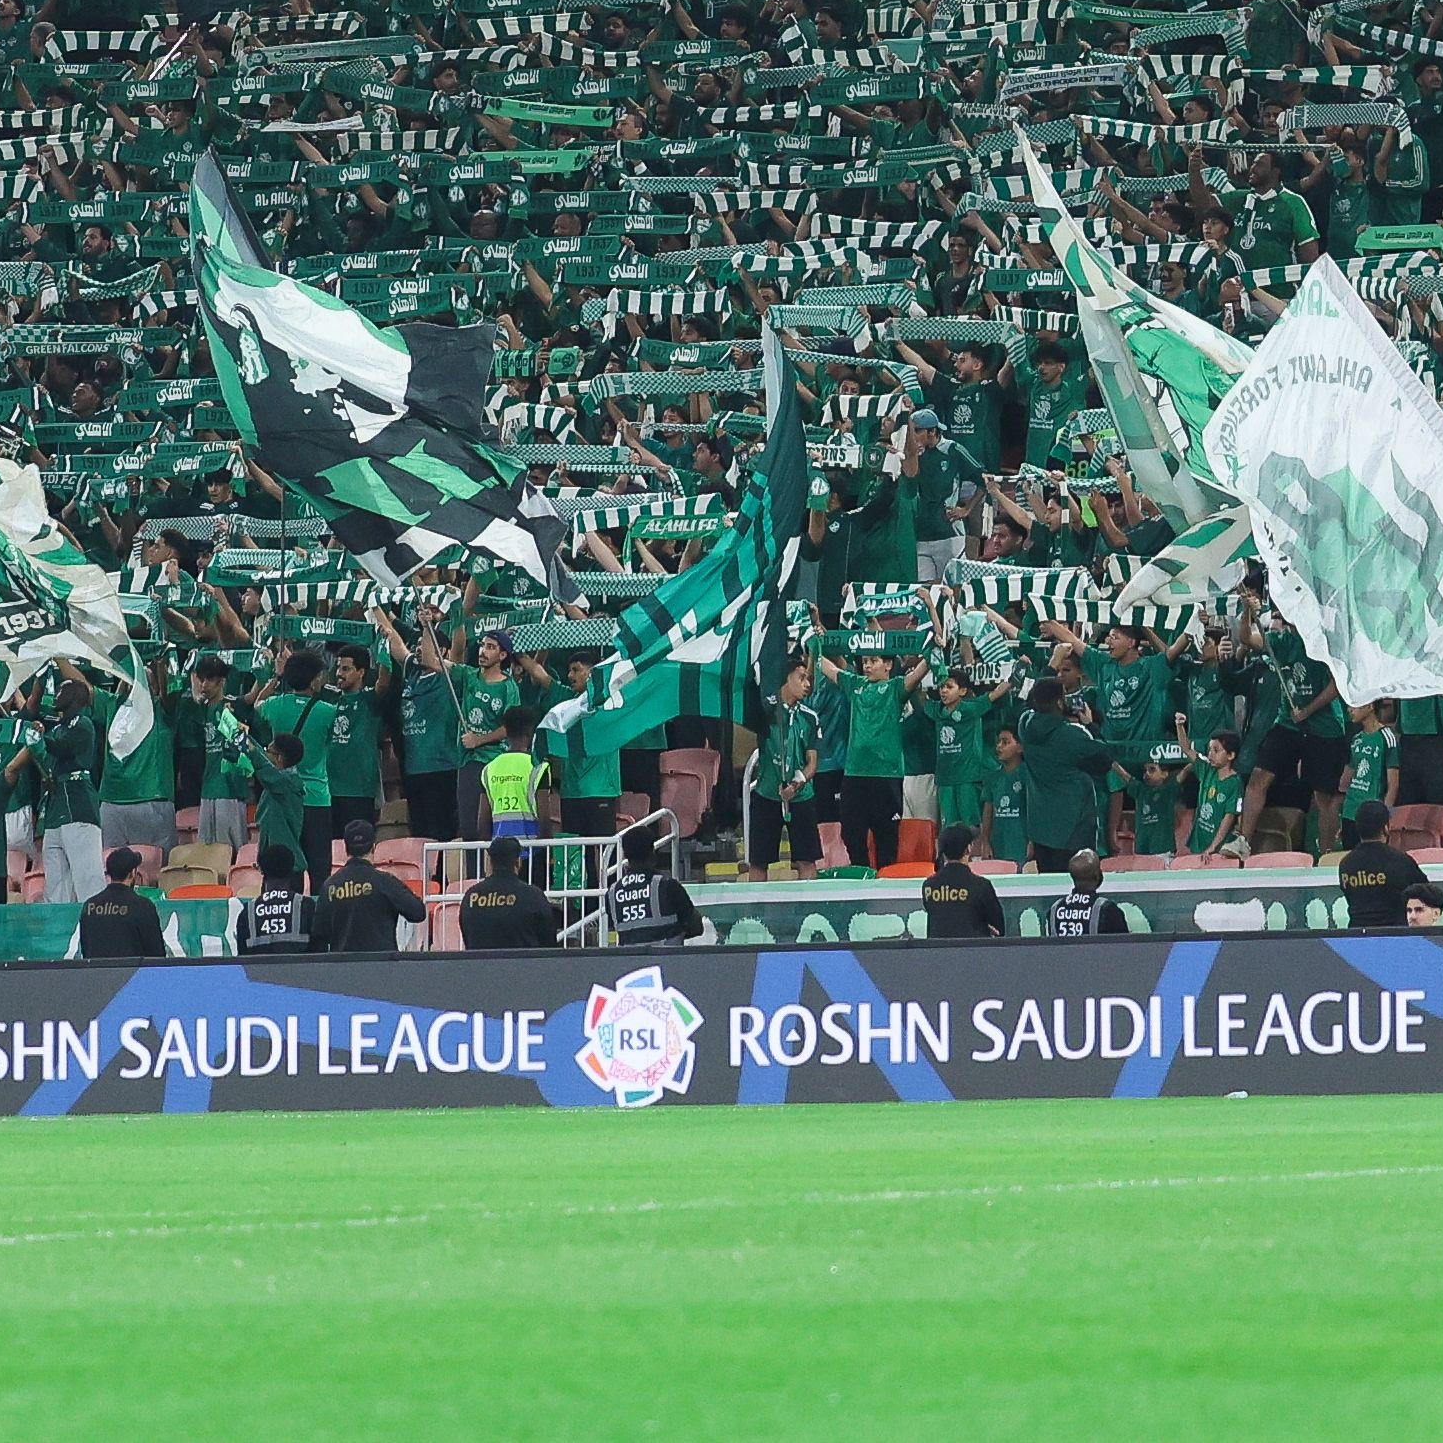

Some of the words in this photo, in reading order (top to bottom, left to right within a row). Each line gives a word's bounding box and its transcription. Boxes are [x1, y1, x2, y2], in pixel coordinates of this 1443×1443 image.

[1233, 220, 1272, 231] SADIA
[25, 344, 59, 355] GREEN
[62, 343, 109, 353] FALCONS
[643, 519, 662, 535] AL
[662, 520, 697, 533] AHLI
[698, 518, 718, 530] FC
[0, 607, 56, 635] 1937
[491, 773, 524, 784] Organizer
[498, 795, 519, 811] 132
[622, 873, 646, 885] EPIC
[1341, 869, 1387, 888] Police
[263, 890, 288, 900] EPIC
[328, 881, 373, 901] Police
[615, 886, 650, 903] Guard
[925, 886, 968, 902] Police
[470, 892, 516, 908] Police
[1066, 894, 1090, 905] EPIC
[256, 901, 292, 916] Guard
[622, 904, 647, 920] 555
[1057, 906, 1092, 921] Guard
[261, 918, 287, 933] 453
[1059, 922, 1084, 936] 539
[730, 1001, 949, 1066] ROSHN
[972, 996, 1161, 1061] SAUDI
[1184, 991, 1425, 1056] LEAGUE
[120, 1016, 297, 1078] SAUDI
[319, 1011, 546, 1074] LEAGUE
[620, 1028, 660, 1049] RSL
